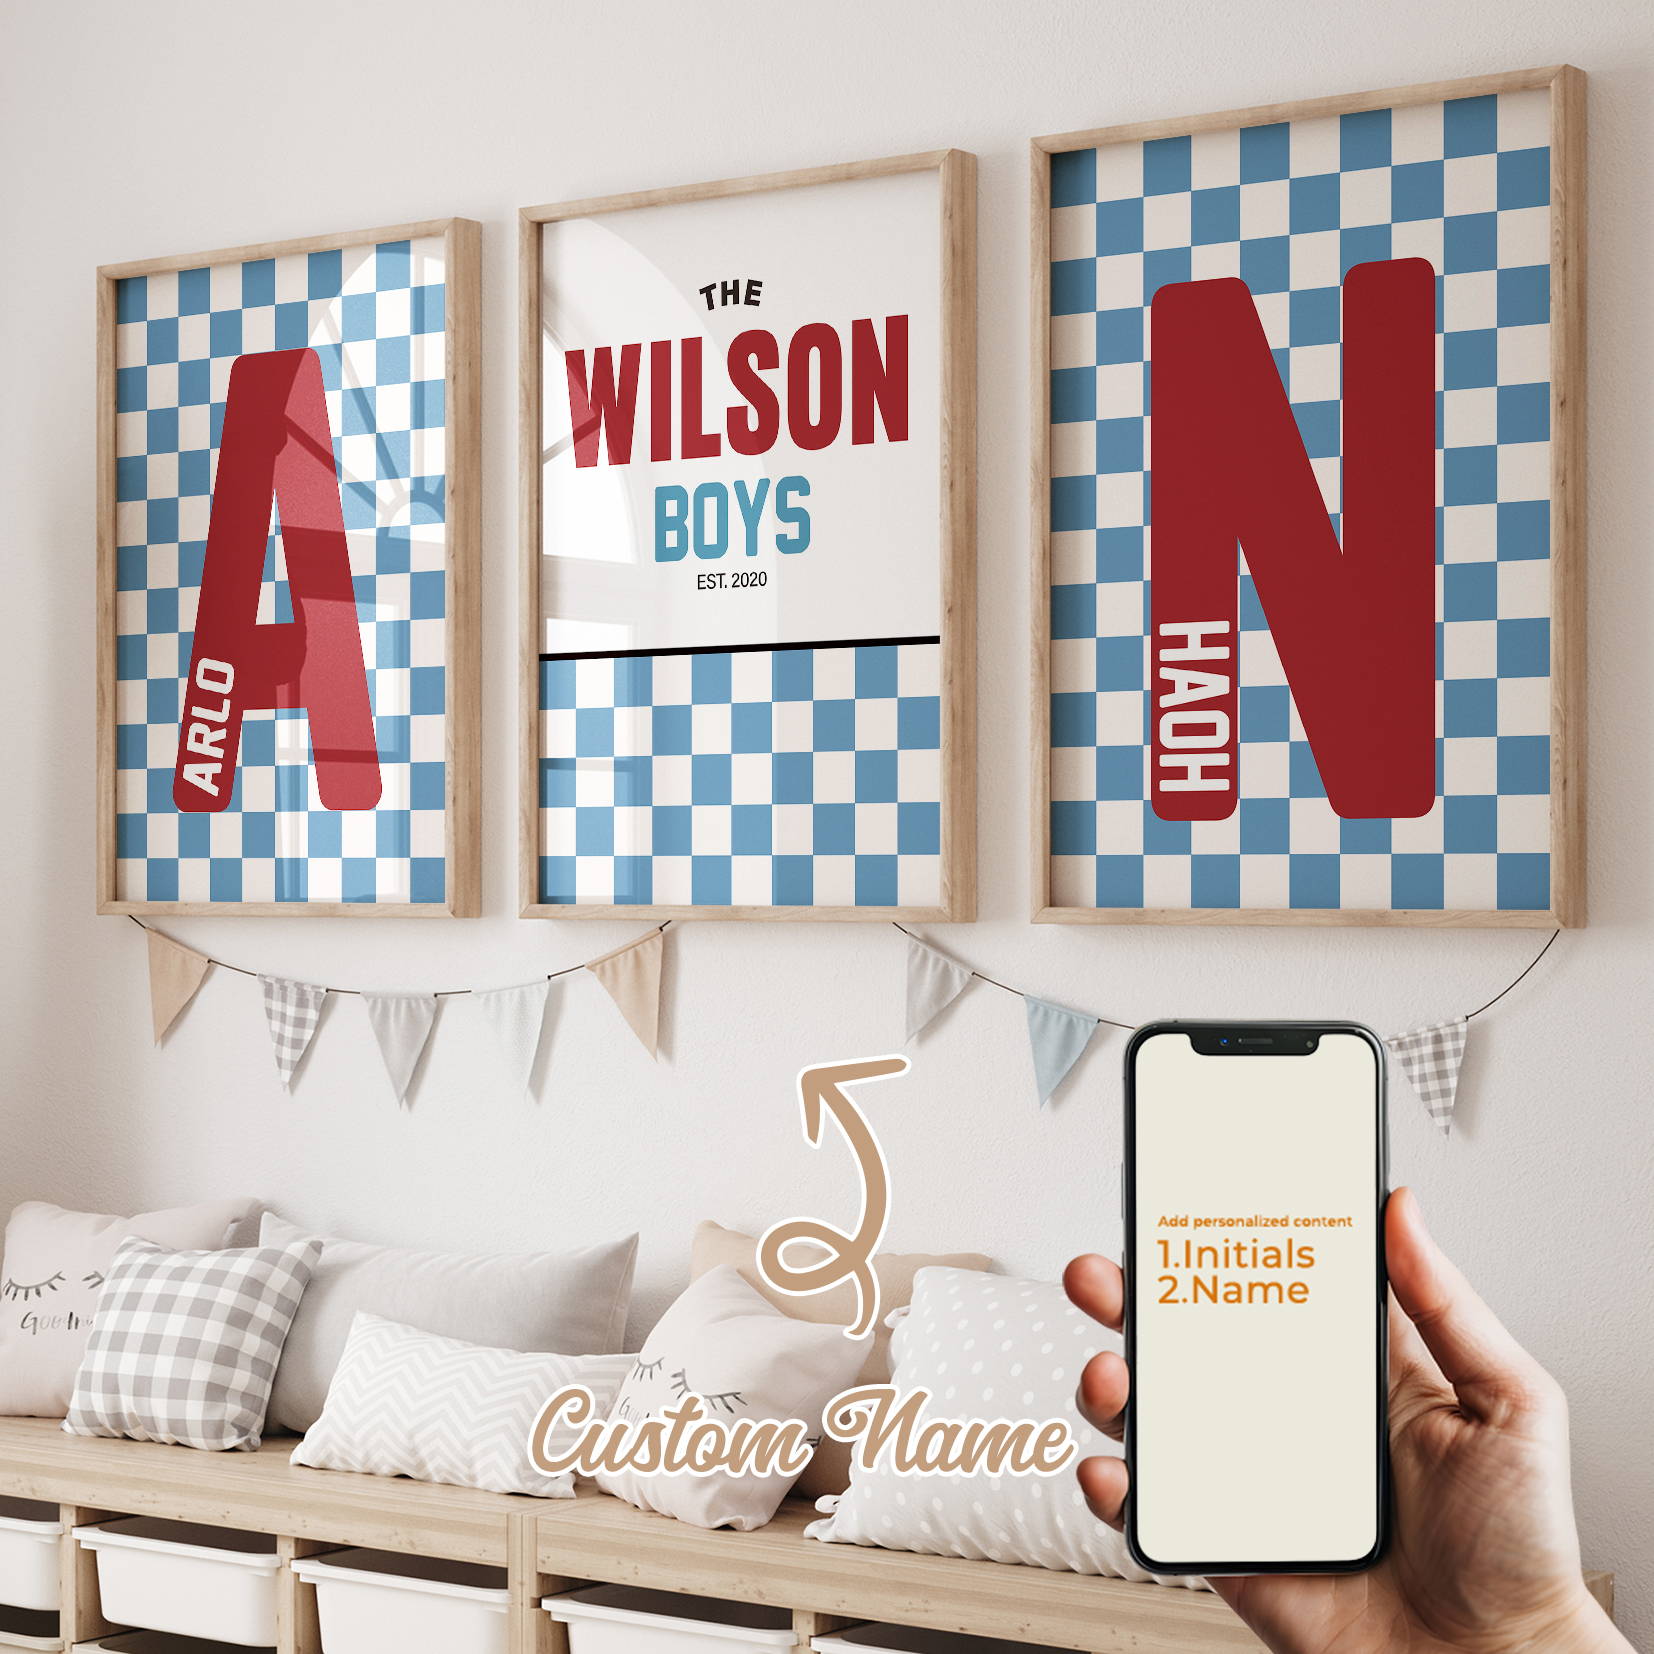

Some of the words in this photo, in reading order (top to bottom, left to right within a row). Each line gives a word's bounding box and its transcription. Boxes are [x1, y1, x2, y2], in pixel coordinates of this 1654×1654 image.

[699, 279, 763, 311] THE
[565, 314, 909, 469] WILSON
[654, 475, 811, 563] BOYS
[1151, 257, 1435, 820] N
[173, 347, 383, 813] A
[697, 573, 728, 590] EST.
[731, 571, 768, 589] 2020
[182, 656, 235, 797] ARLO
[1159, 620, 1230, 792] HAOH
[1157, 1214, 1189, 1228] Add
[1193, 1214, 1290, 1231] personalized
[1293, 1215, 1353, 1228] content
[1157, 1238, 1316, 1269] 1.Initials
[1157, 1274, 1310, 1305] 2.Name
